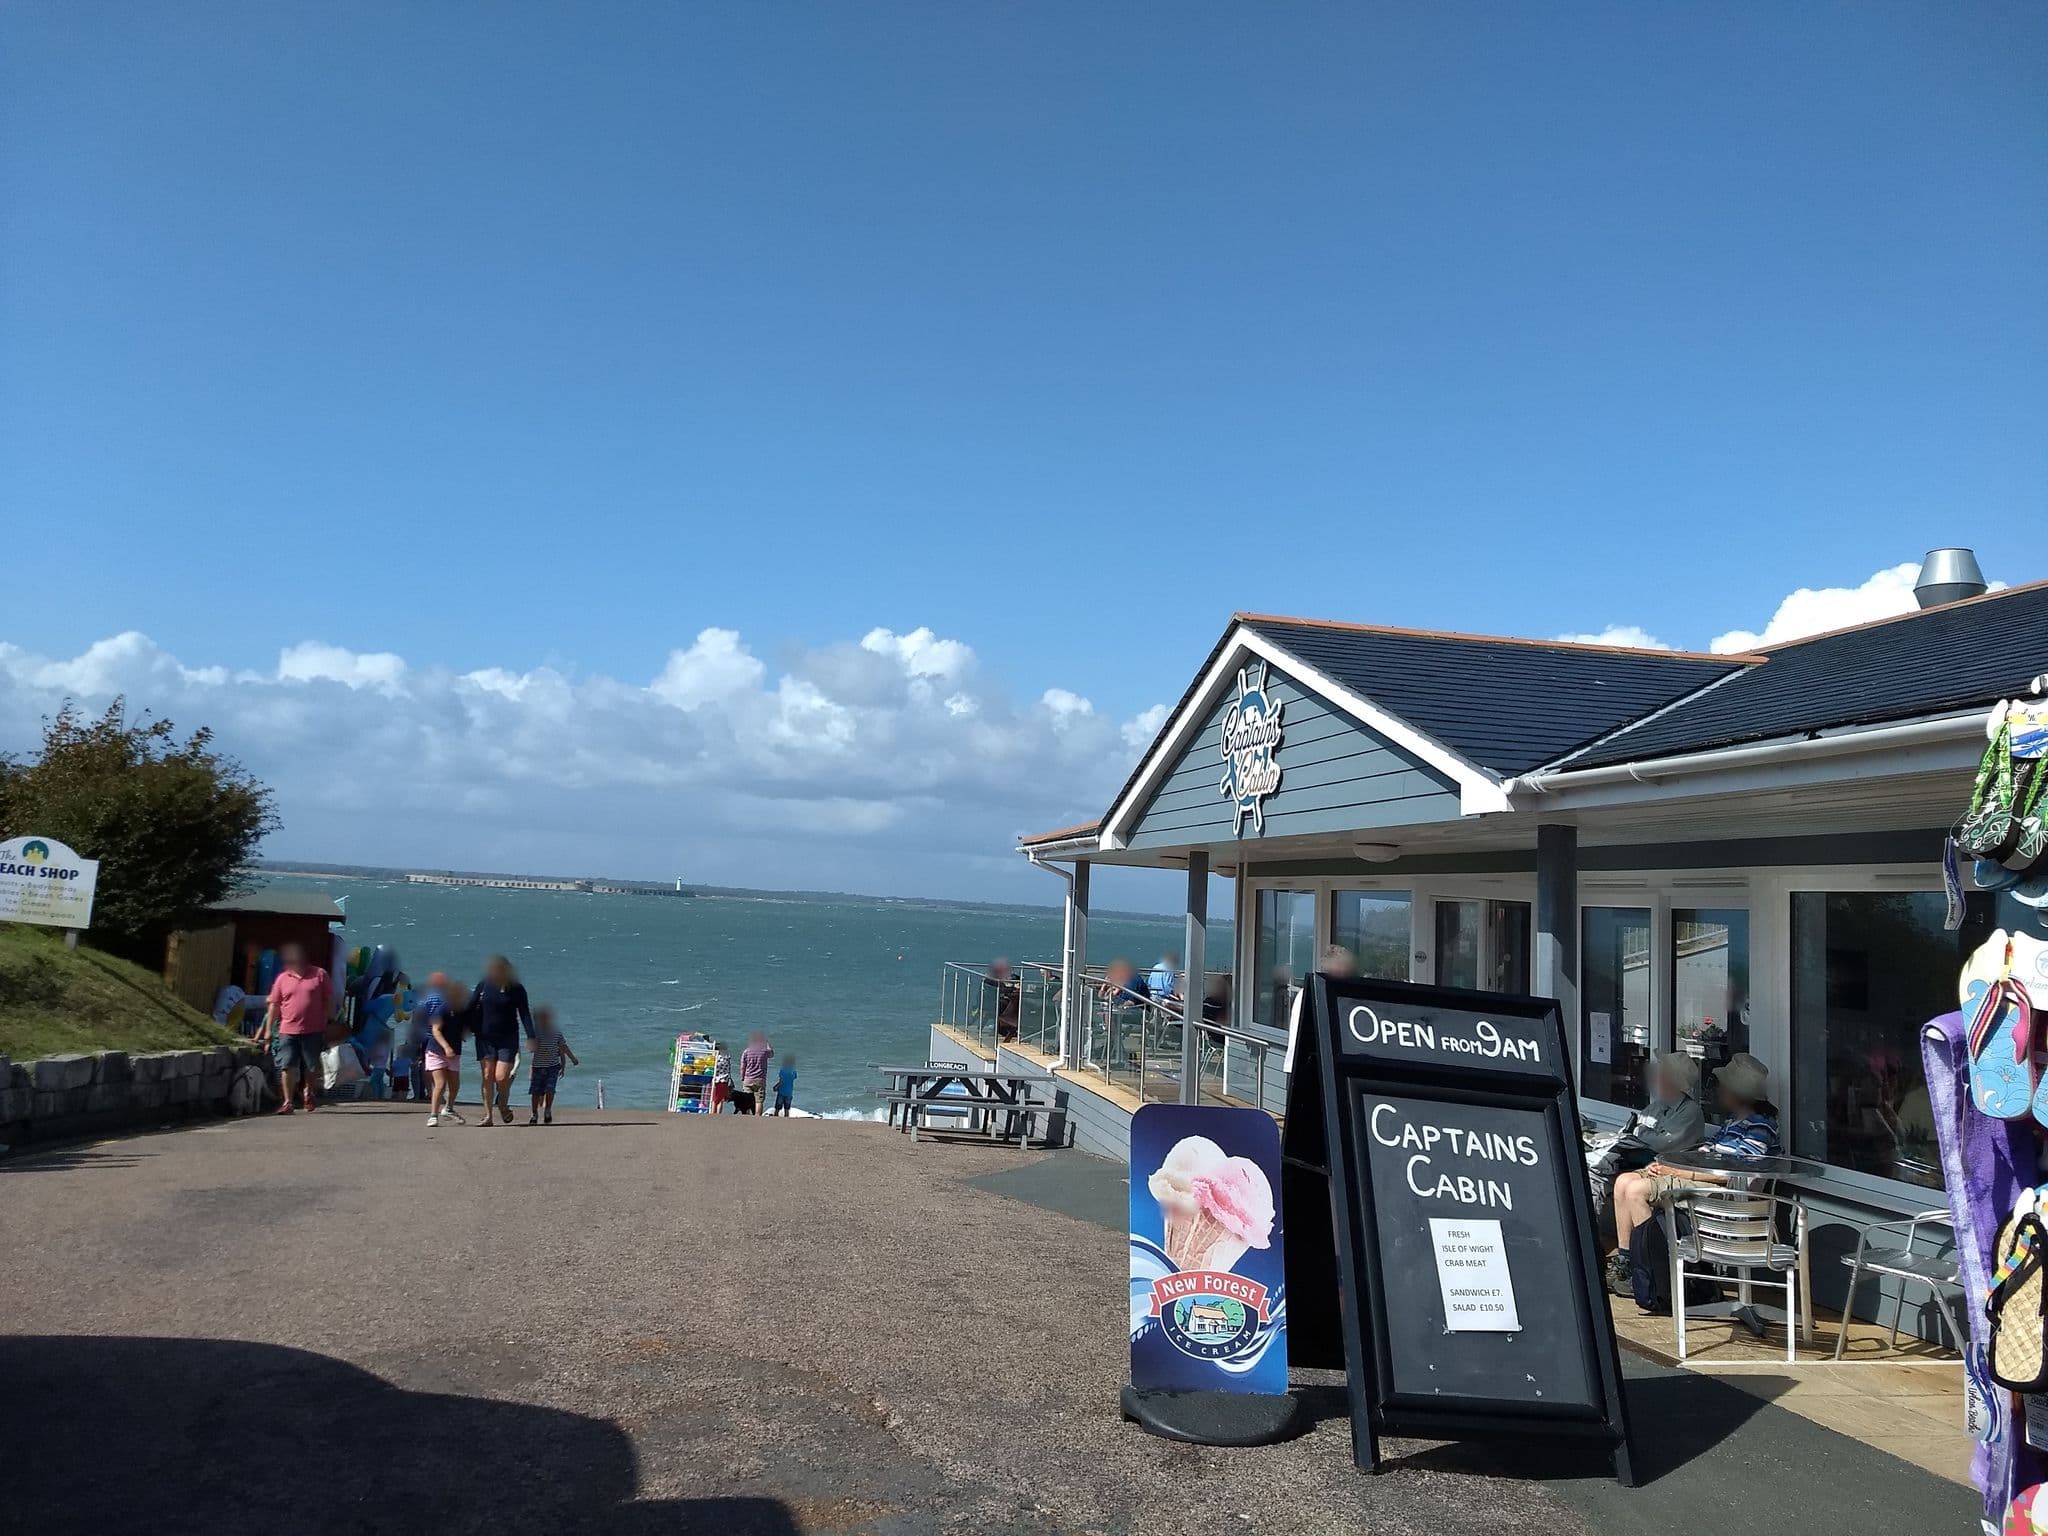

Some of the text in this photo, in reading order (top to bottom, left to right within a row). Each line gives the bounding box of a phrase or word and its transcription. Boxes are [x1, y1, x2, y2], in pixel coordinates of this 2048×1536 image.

[1221, 705, 1280, 755] Captains
[1237, 751, 1278, 797] Cabin
[0, 849, 17, 861] The
[40, 867, 79, 880] SHOP
[1349, 1006, 1435, 1050] OPEN
[1441, 1036, 1483, 1055] FROM
[1476, 1020, 1541, 1063] 9AM
[1371, 1103, 1539, 1166] CAPTAINS
[1406, 1154, 1513, 1211] CABIN
[1447, 1230, 1471, 1239] FRESH
[1442, 1245, 1495, 1253] ISLE OF WIGHT
[1444, 1259, 1487, 1268] CRAB MEAT
[1161, 1275, 1258, 1301] New Forest
[1449, 1288, 1491, 1297] SANDWICH
[1452, 1303, 1505, 1312] SALAD £10.50
[1169, 1326, 1252, 1355] ICE CREAM
